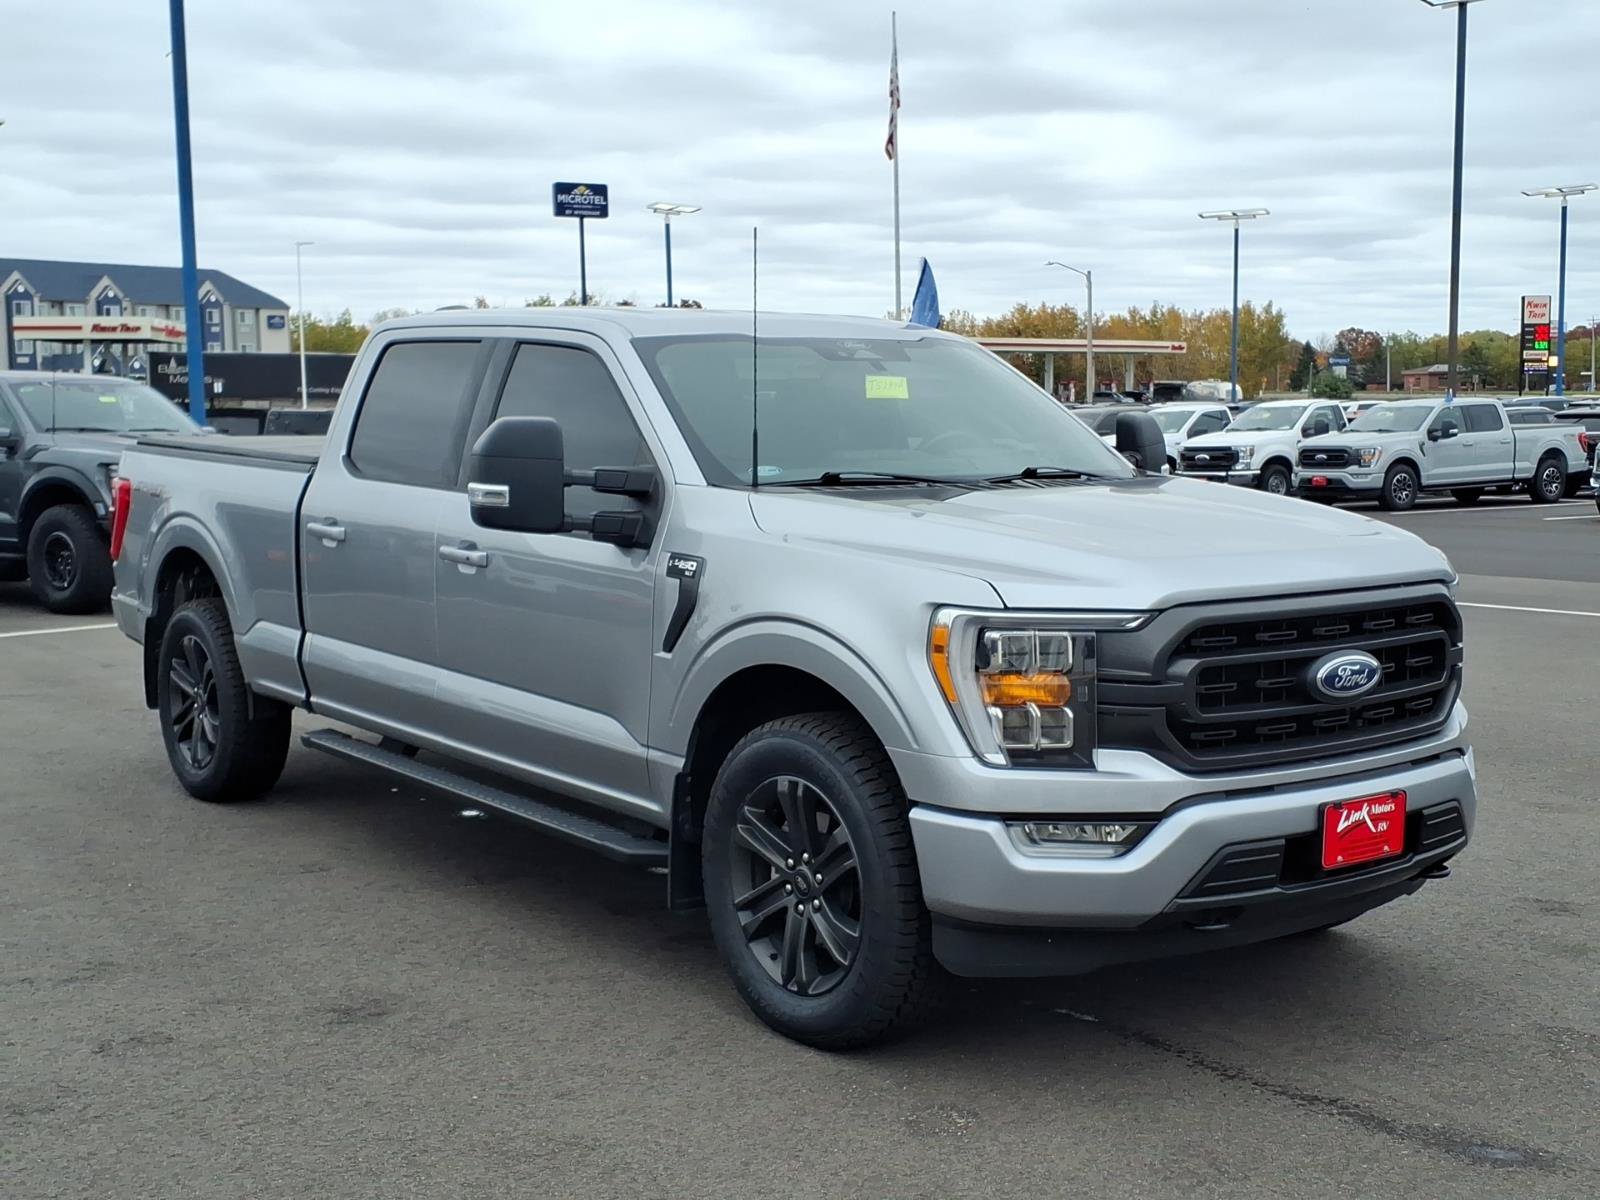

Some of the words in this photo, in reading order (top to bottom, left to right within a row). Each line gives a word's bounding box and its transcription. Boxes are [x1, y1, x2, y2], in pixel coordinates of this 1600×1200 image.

[557, 194, 607, 205] MICROTEL
[1526, 301, 1547, 310] KWIK
[1528, 310, 1546, 319] TRIP
[1335, 664, 1369, 688] Ford
[1336, 802, 1376, 833] Link
[1370, 803, 1396, 815] Motors
[1377, 821, 1390, 832] RV
